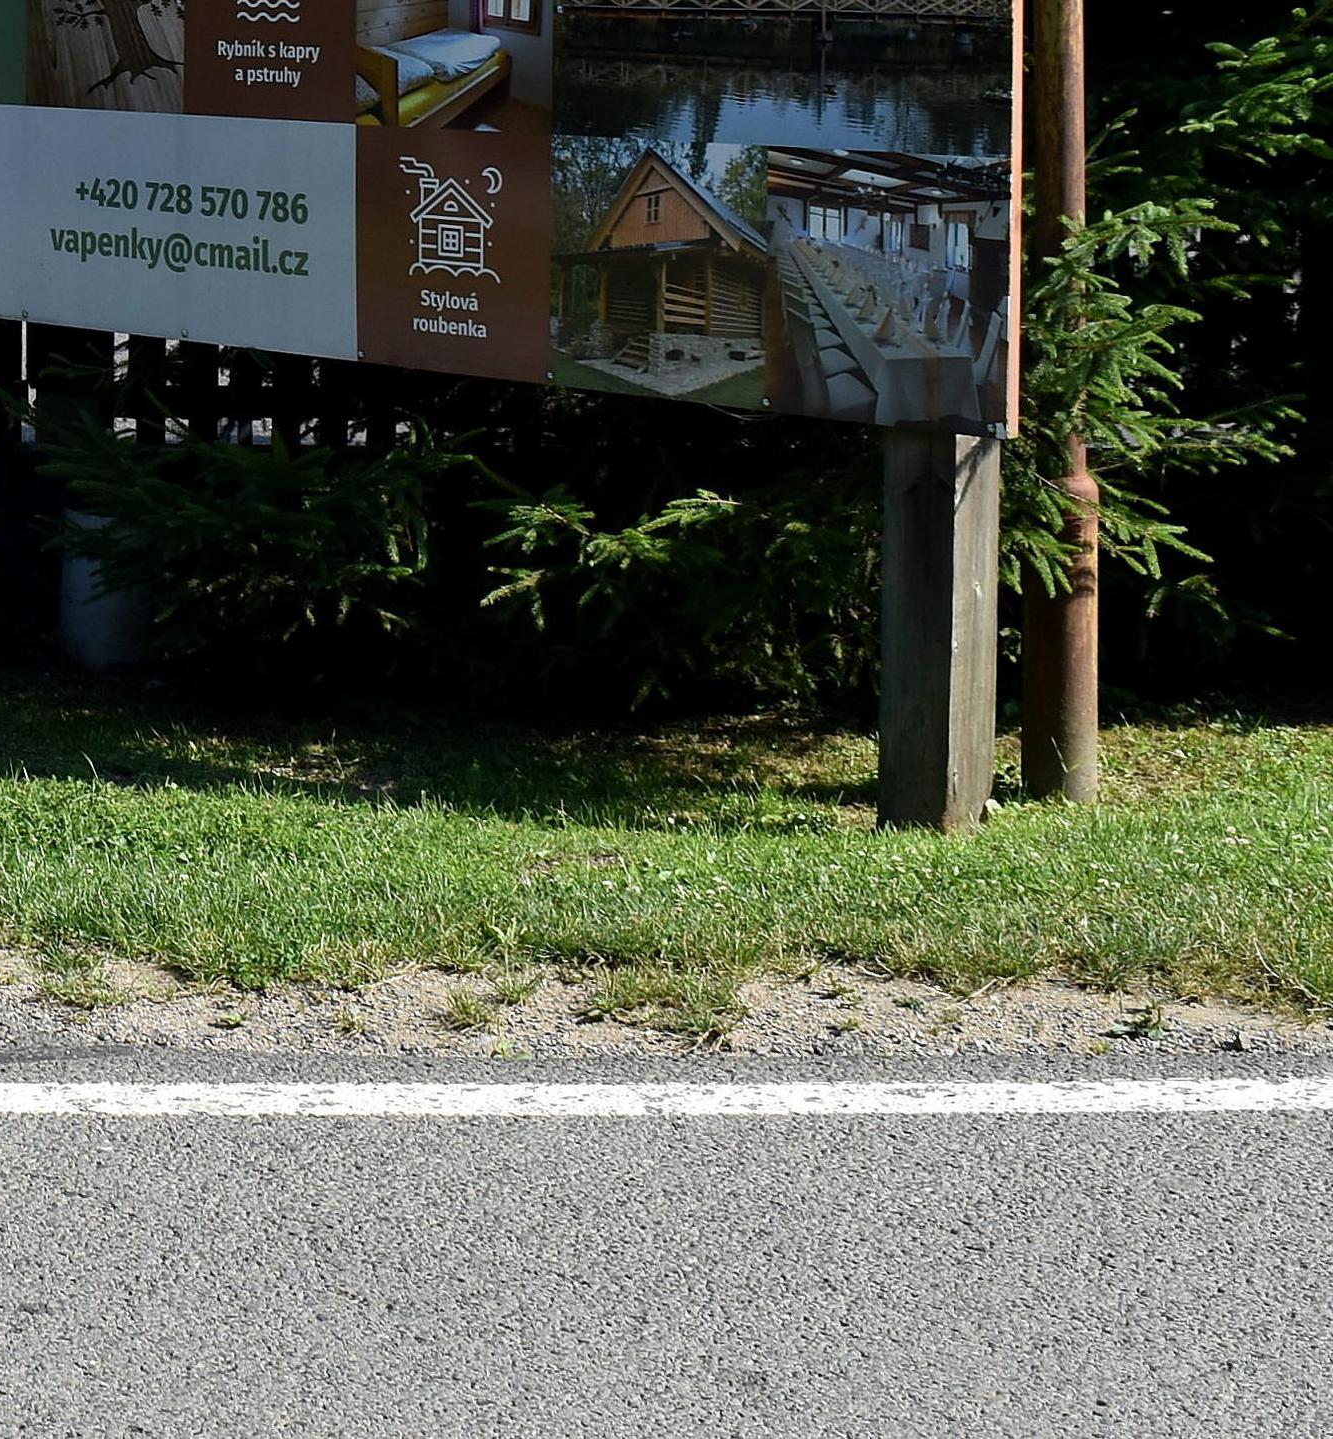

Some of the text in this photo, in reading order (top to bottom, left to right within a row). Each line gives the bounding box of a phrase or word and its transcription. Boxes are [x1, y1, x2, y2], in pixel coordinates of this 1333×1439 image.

[217, 39, 320, 64] Rybník s kapry
[235, 66, 301, 88] a pstruhy
[75, 177, 309, 225] +420 728 570 786
[50, 226, 310, 277] vapenky@cmail.cz
[420, 289, 479, 312] Stylová
[413, 315, 487, 338] roubenka
